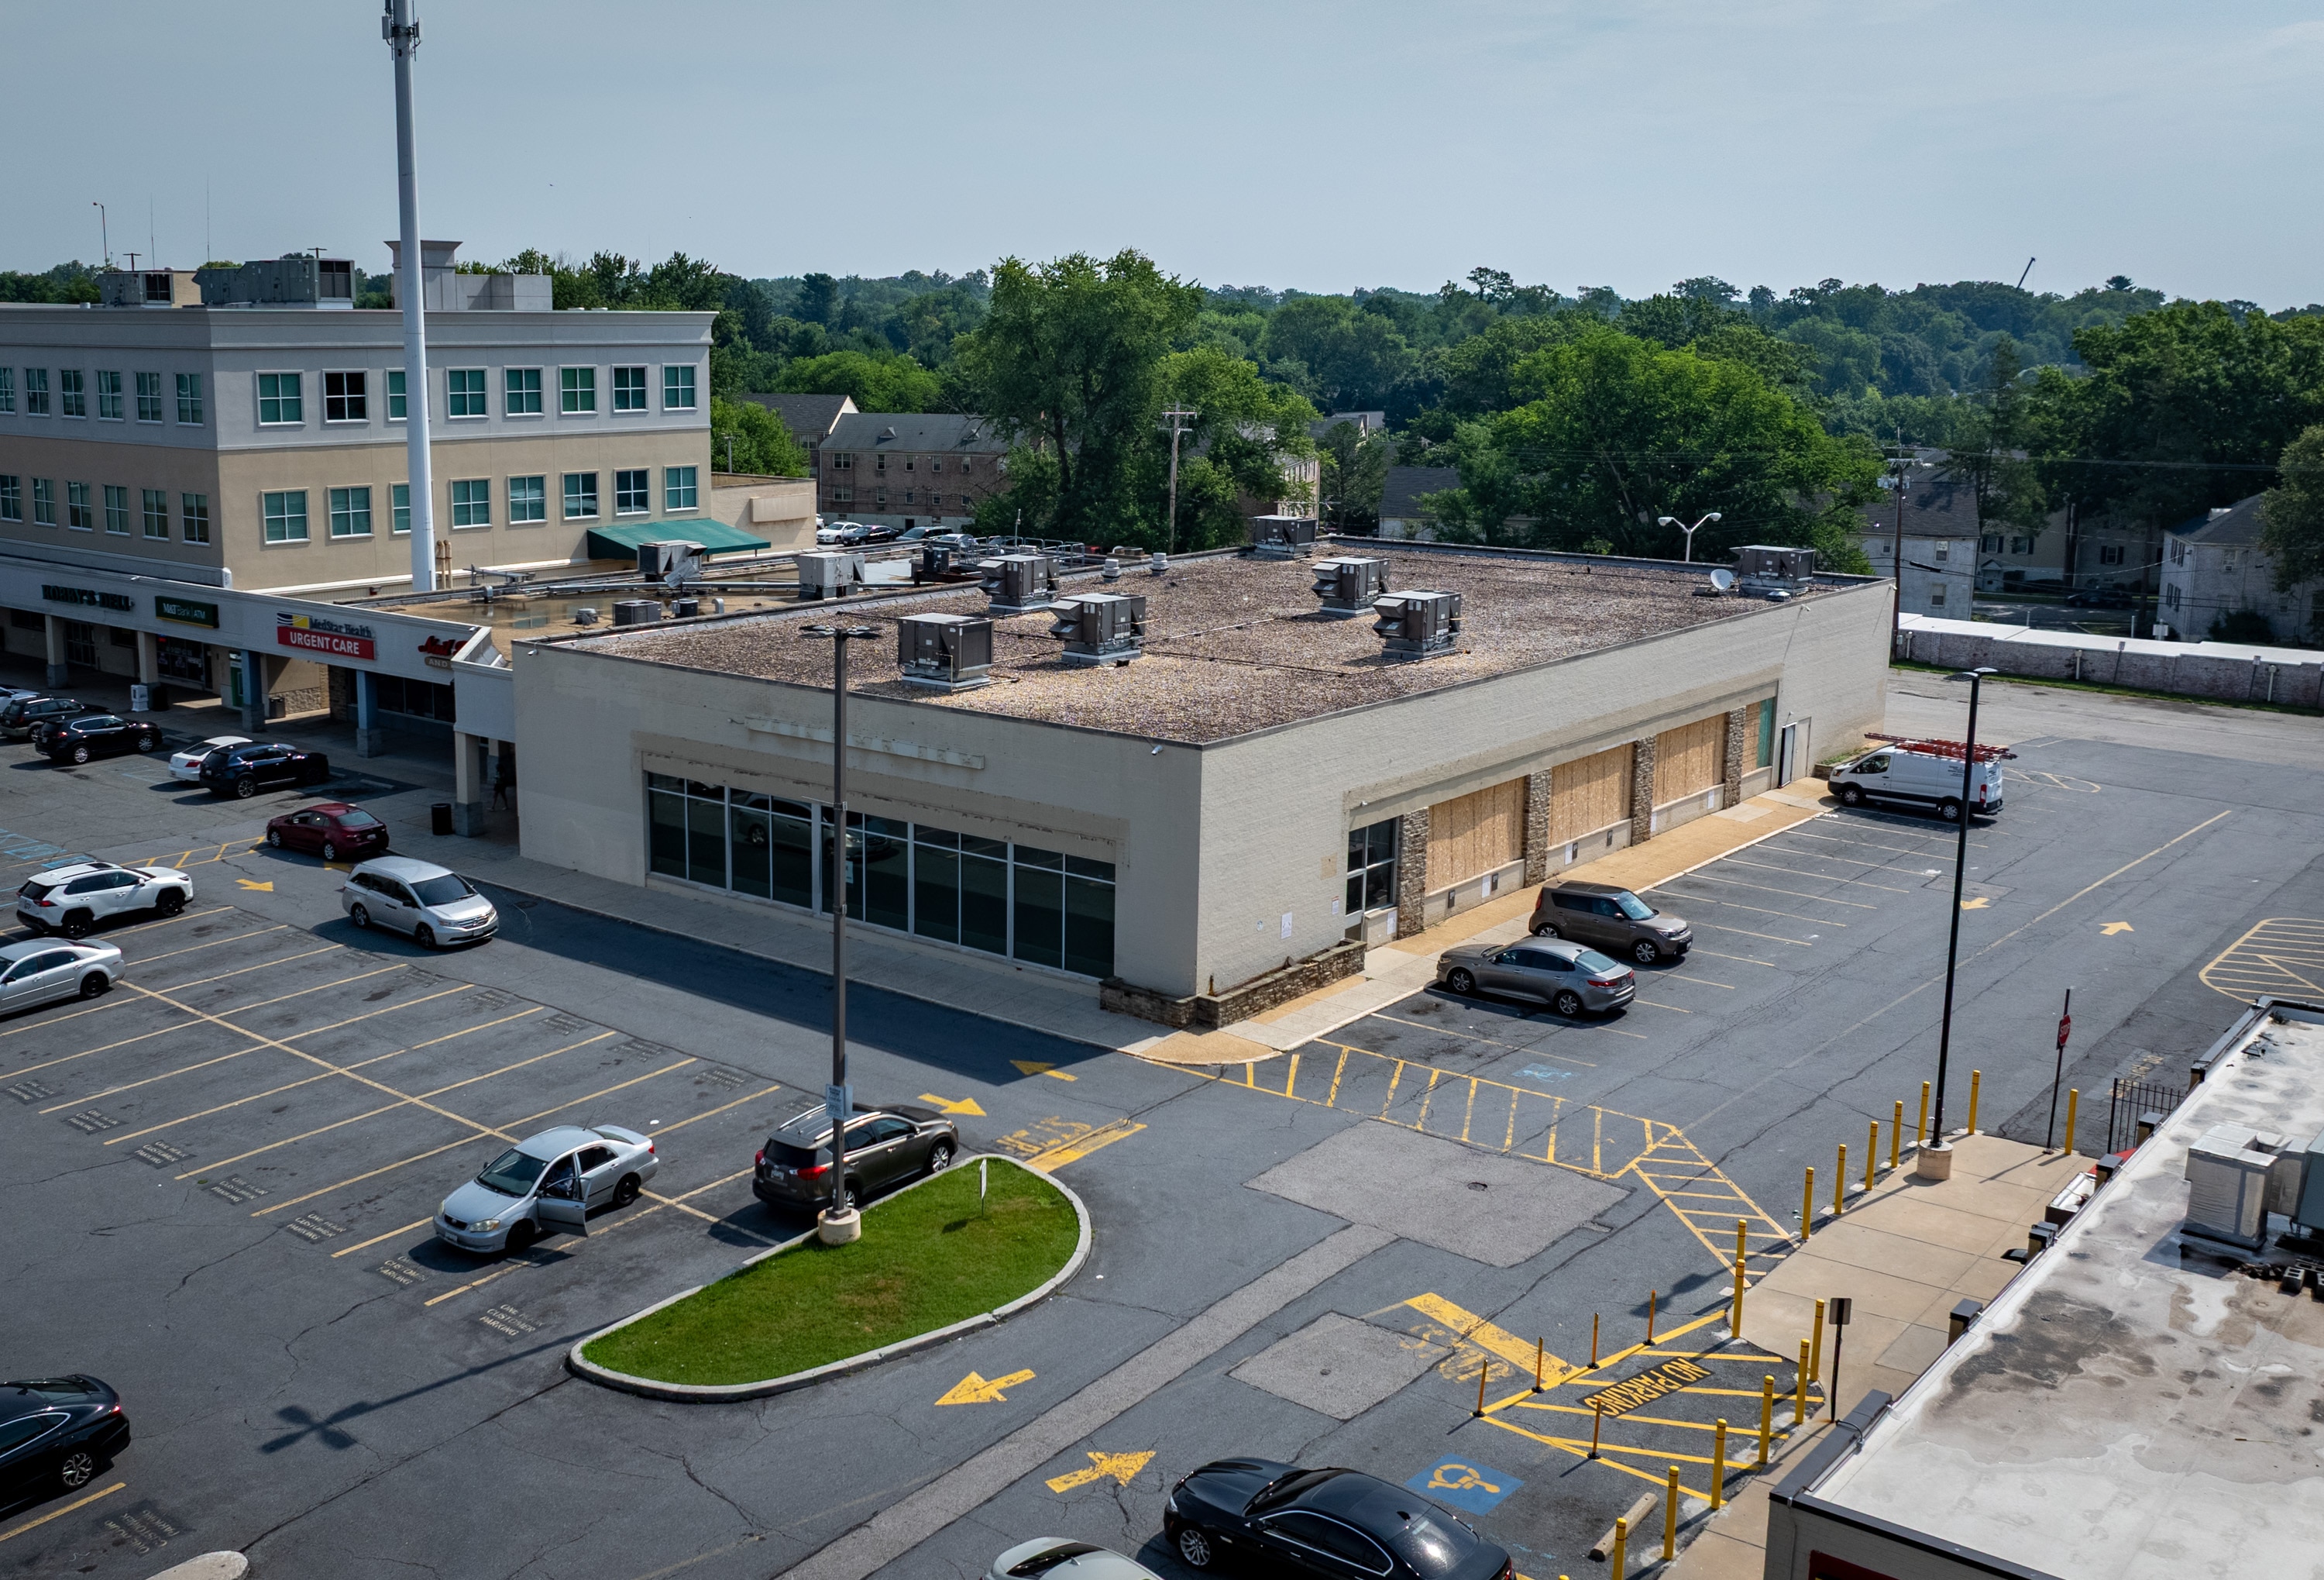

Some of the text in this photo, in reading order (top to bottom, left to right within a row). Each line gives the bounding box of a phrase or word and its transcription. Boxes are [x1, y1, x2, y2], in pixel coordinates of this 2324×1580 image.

[98, 592, 130, 611] DELI
[163, 602, 205, 619] M&T Bank ATM
[310, 618, 372, 638] MedStar Health
[290, 632, 359, 655] URGENT CARE
[2060, 1023, 2071, 1037] STOP
[67, 1117, 96, 1131] PARKING
[76, 1113, 110, 1129] CUSTOMER
[134, 1150, 162, 1164] PARKING
[143, 1144, 179, 1162] CUSTOMER
[211, 1186, 242, 1203] PARKING
[219, 1180, 258, 1200] CUSTOMER
[286, 1223, 321, 1241] PARKING
[294, 1217, 337, 1238] CUSTOMER
[500, 1303, 519, 1316] ONE
[479, 1316, 520, 1337] PARKING
[486, 1307, 536, 1333] CUSTOMER
[1584, 1357, 1711, 1416] NO PARKING
[142, 1509, 180, 1537] PARKING
